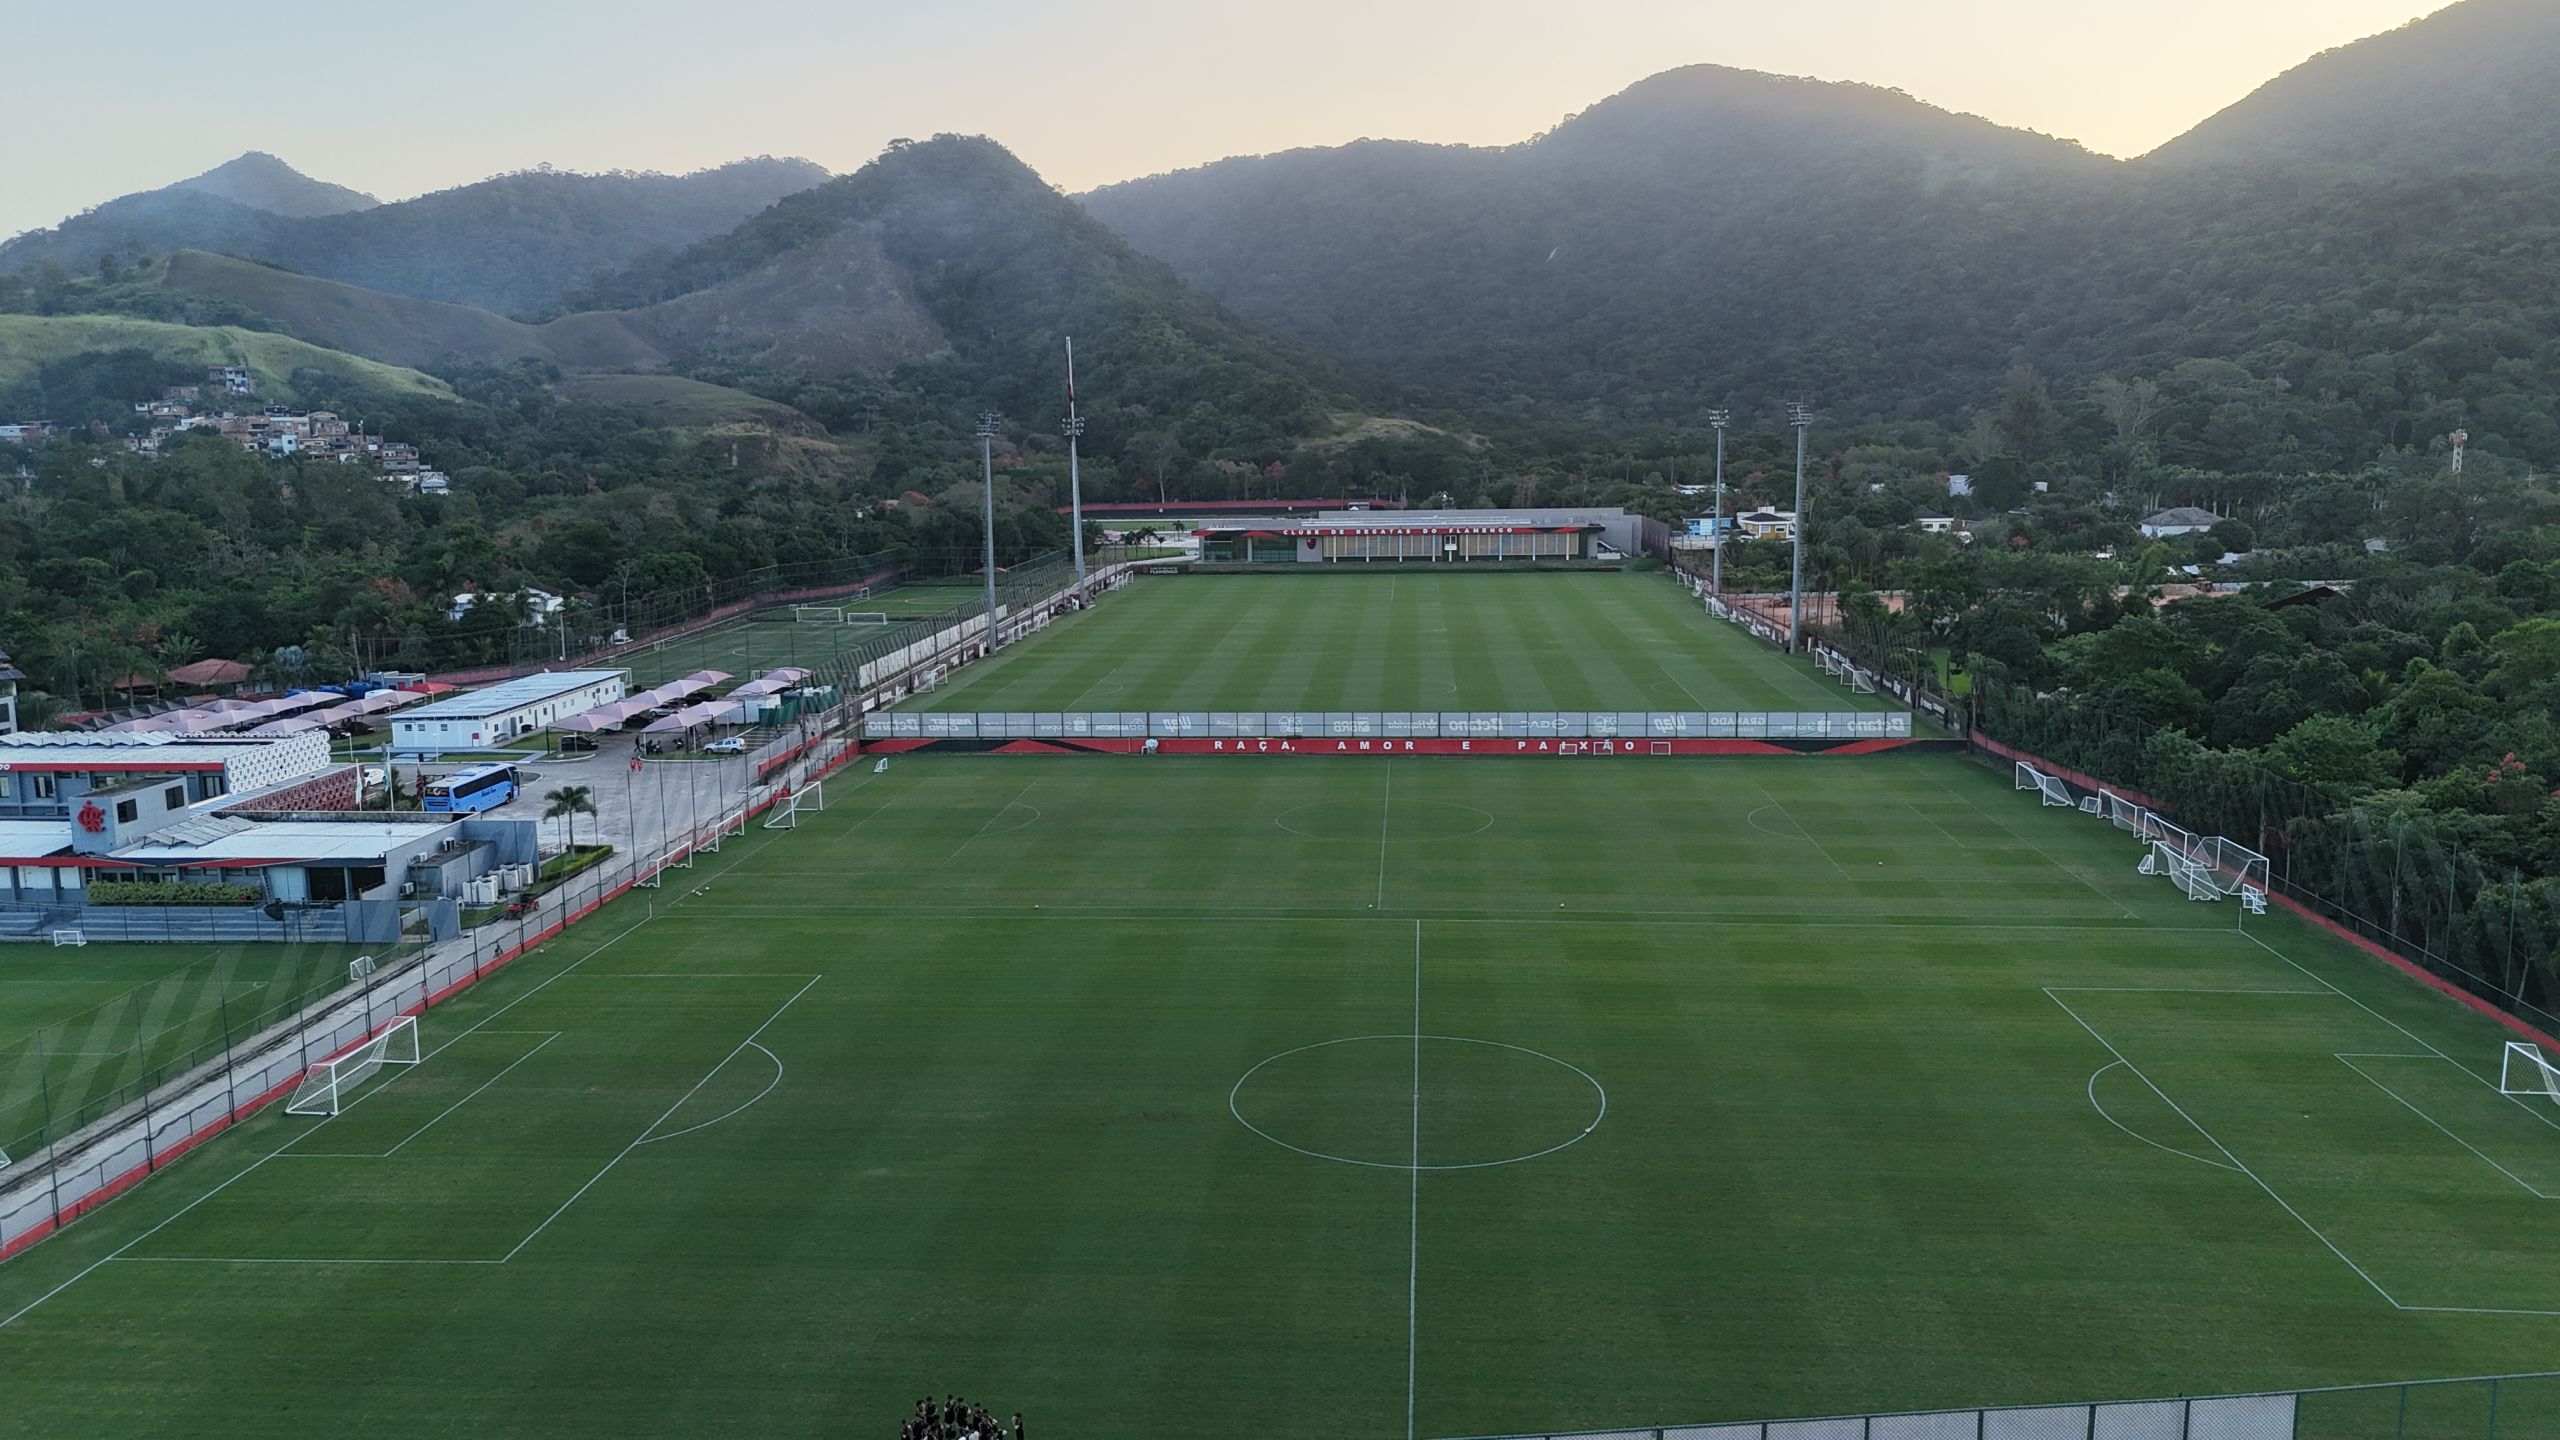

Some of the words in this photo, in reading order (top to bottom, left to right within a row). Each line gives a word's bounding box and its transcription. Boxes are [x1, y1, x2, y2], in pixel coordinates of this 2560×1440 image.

[1214, 740, 1296, 752] RAÇA,
[1337, 740, 1414, 750] AMOR
[1462, 740, 1470, 750] E
[1518, 739, 1634, 750] PAIXÃO
